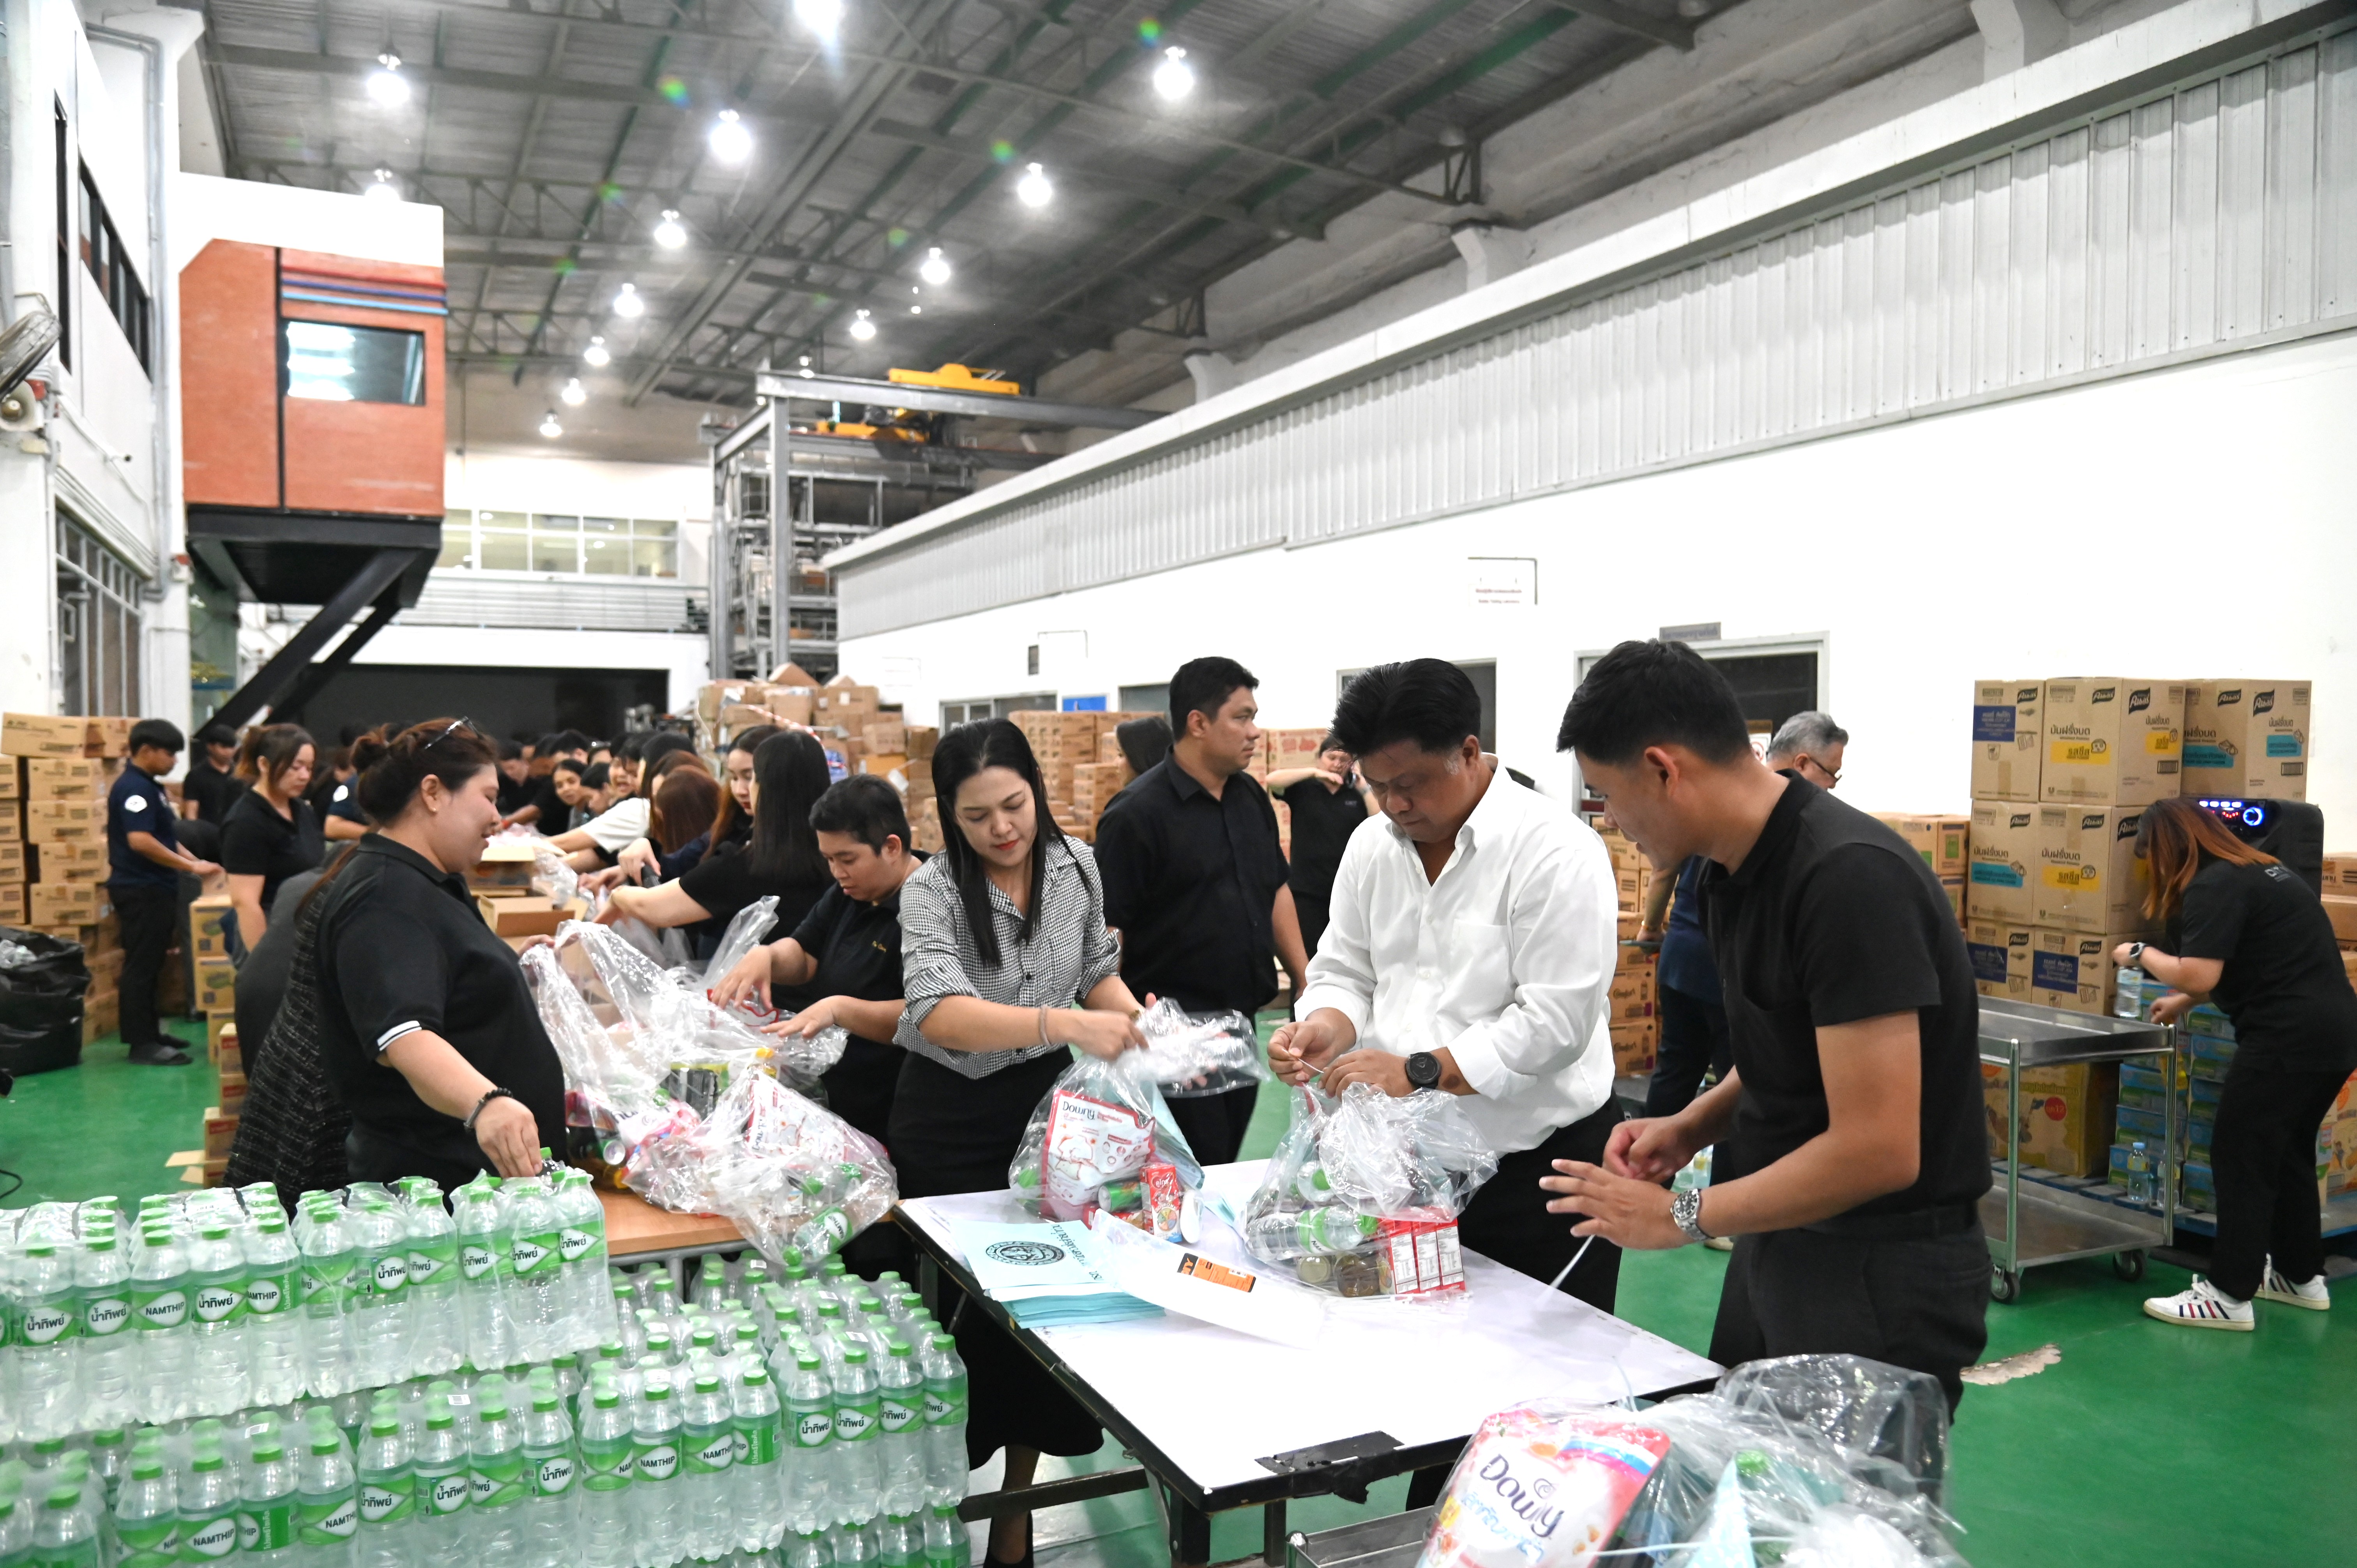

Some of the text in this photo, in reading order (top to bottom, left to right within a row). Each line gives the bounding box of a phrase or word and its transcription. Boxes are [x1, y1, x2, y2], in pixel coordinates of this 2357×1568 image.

[2051, 723, 2090, 735] มันฝรั่งบด
[1974, 845, 2009, 858] มันฝรั่งบด
[2042, 847, 2080, 861] มันฝรั่งบด
[1063, 1101, 1095, 1120] Downy
[198, 1293, 234, 1308] น้ำทิพย์
[91, 1303, 127, 1322] น้ำทิพย์
[145, 1301, 185, 1316] NAMTHIP
[28, 1314, 64, 1331] น้ำทิพย์
[802, 1418, 830, 1434] น้ำทิพย์
[640, 1456, 675, 1468] NAMTHIP
[193, 1527, 235, 1547] NAMTHIP
